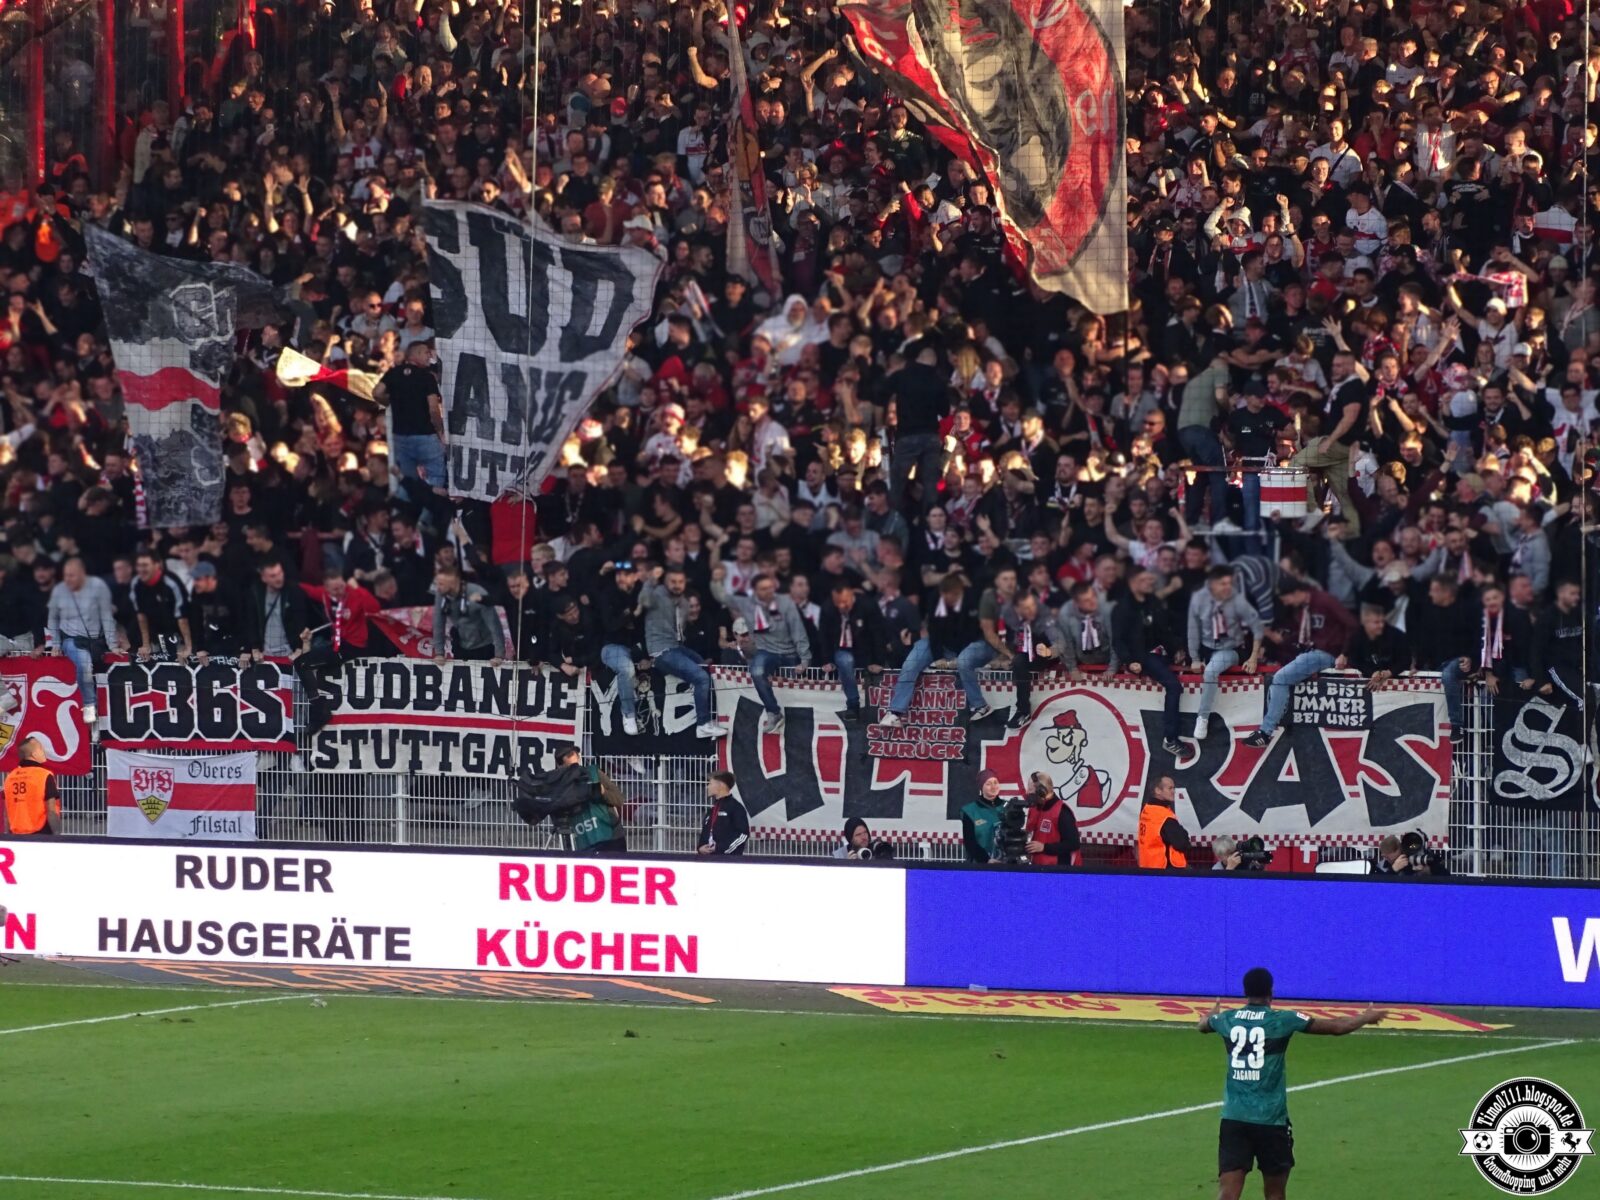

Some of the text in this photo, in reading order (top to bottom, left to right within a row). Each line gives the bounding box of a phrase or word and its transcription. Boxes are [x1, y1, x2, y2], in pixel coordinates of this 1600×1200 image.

[315, 658, 579, 720] SÜDBANDE
[1294, 681, 1367, 698] DU BIST
[107, 661, 287, 743] C36S
[1293, 695, 1367, 714] IMMER
[1293, 711, 1368, 727] BEI UNS!
[187, 759, 243, 779] Oberes
[13, 781, 27, 795] 38
[187, 814, 242, 836] Filstal
[575, 816, 598, 835] OST
[175, 854, 334, 893] RUDER
[498, 862, 678, 906] RUDER
[98, 916, 412, 962] HAUSGERÄTE
[476, 920, 698, 973] KÜCHEN
[1230, 1025, 1265, 1069] 23
[1232, 1069, 1260, 1081] ZAGADOU
